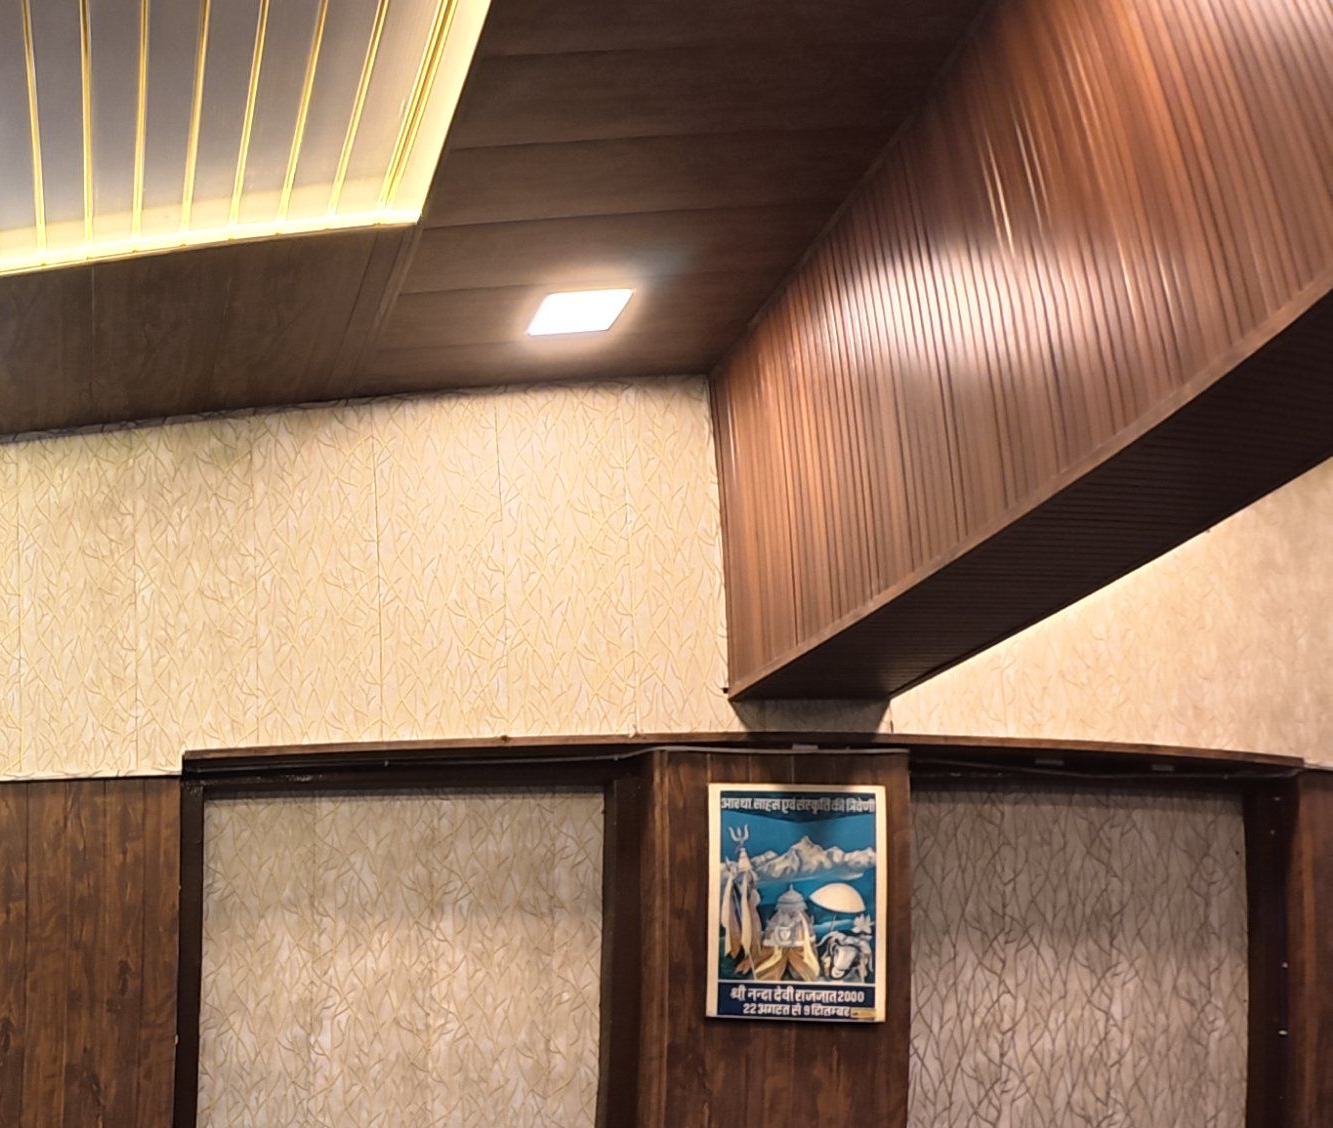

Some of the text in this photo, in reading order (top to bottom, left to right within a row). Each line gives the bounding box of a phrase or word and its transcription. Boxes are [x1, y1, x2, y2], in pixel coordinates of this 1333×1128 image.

[747, 988, 772, 1002] नन्दा
[773, 985, 794, 1002] देवी
[838, 991, 865, 1003] 2000
[743, 1003, 758, 1014] 22
[791, 1003, 802, 1017] से
